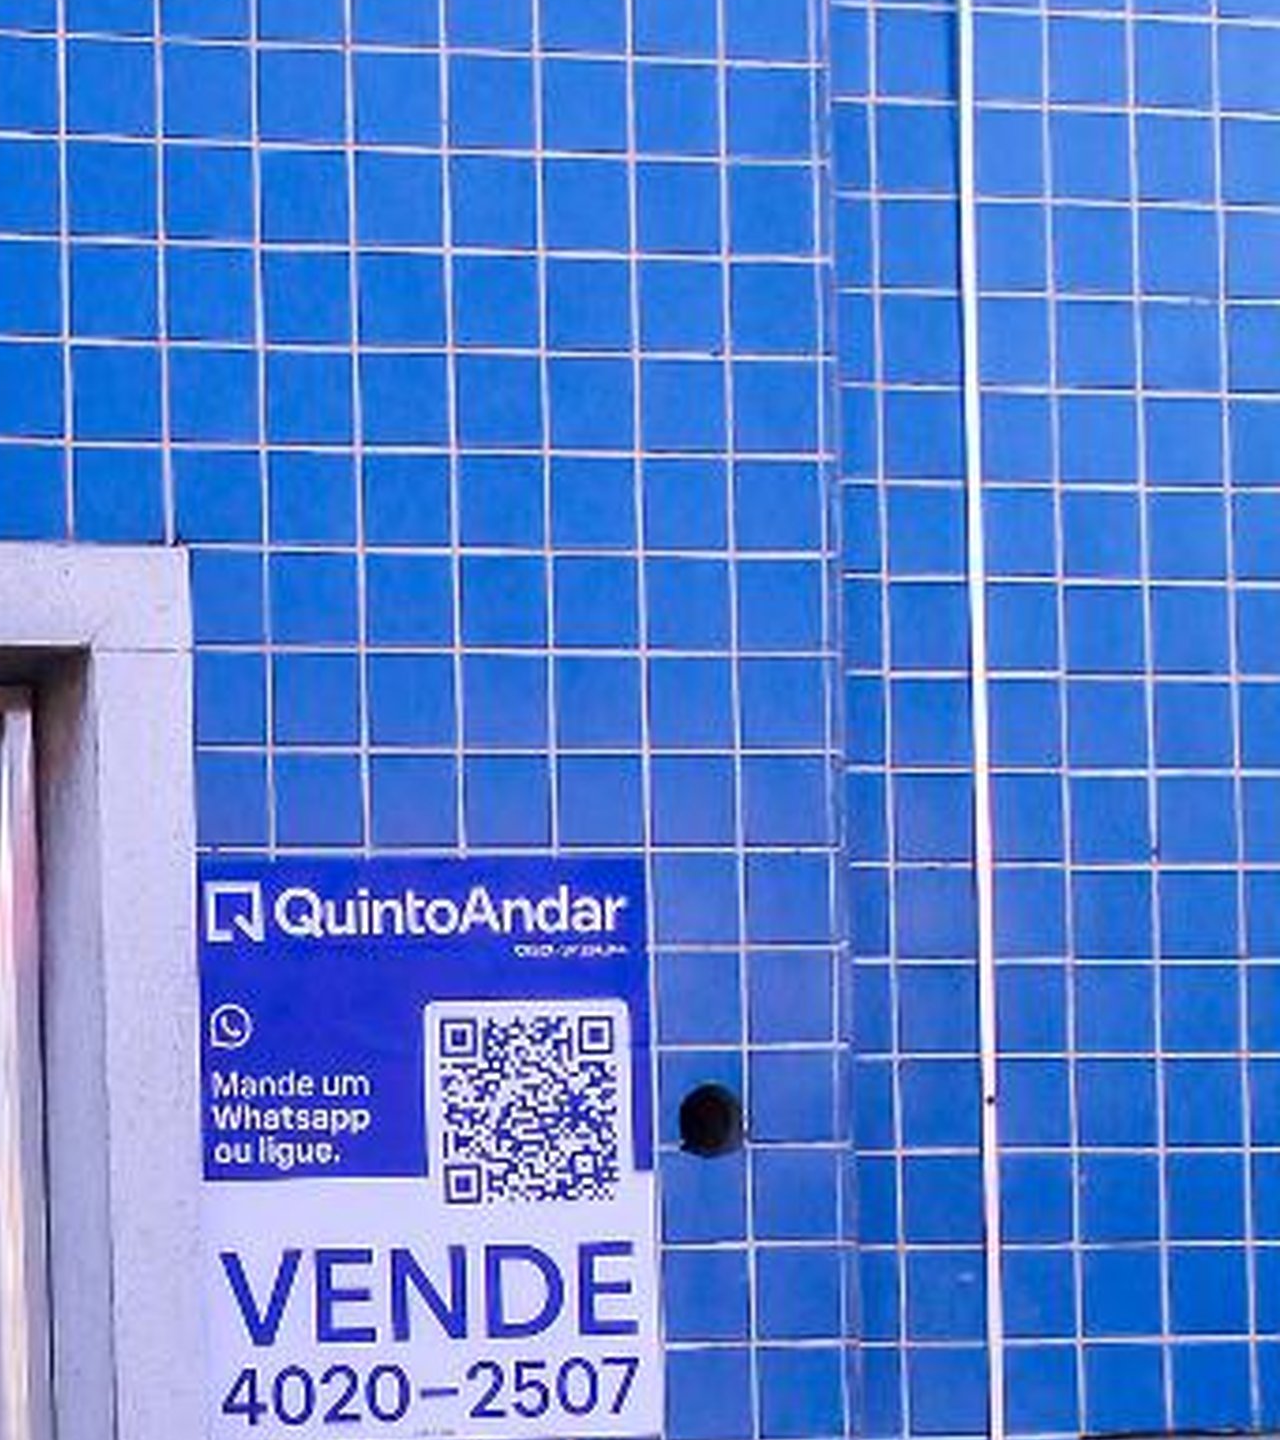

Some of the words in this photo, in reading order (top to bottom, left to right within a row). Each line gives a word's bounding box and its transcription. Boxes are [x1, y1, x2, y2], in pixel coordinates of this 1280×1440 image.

[273, 884, 628, 938] QuintoAndar
[212, 1071, 315, 1098] Mande
[321, 1075, 371, 1098] um
[212, 1104, 371, 1136] Whatsapp
[213, 1141, 254, 1165] ou
[258, 1135, 342, 1171] ligue.
[219, 1240, 640, 1348] VENDE
[221, 1356, 640, 1428] 4020-2507
